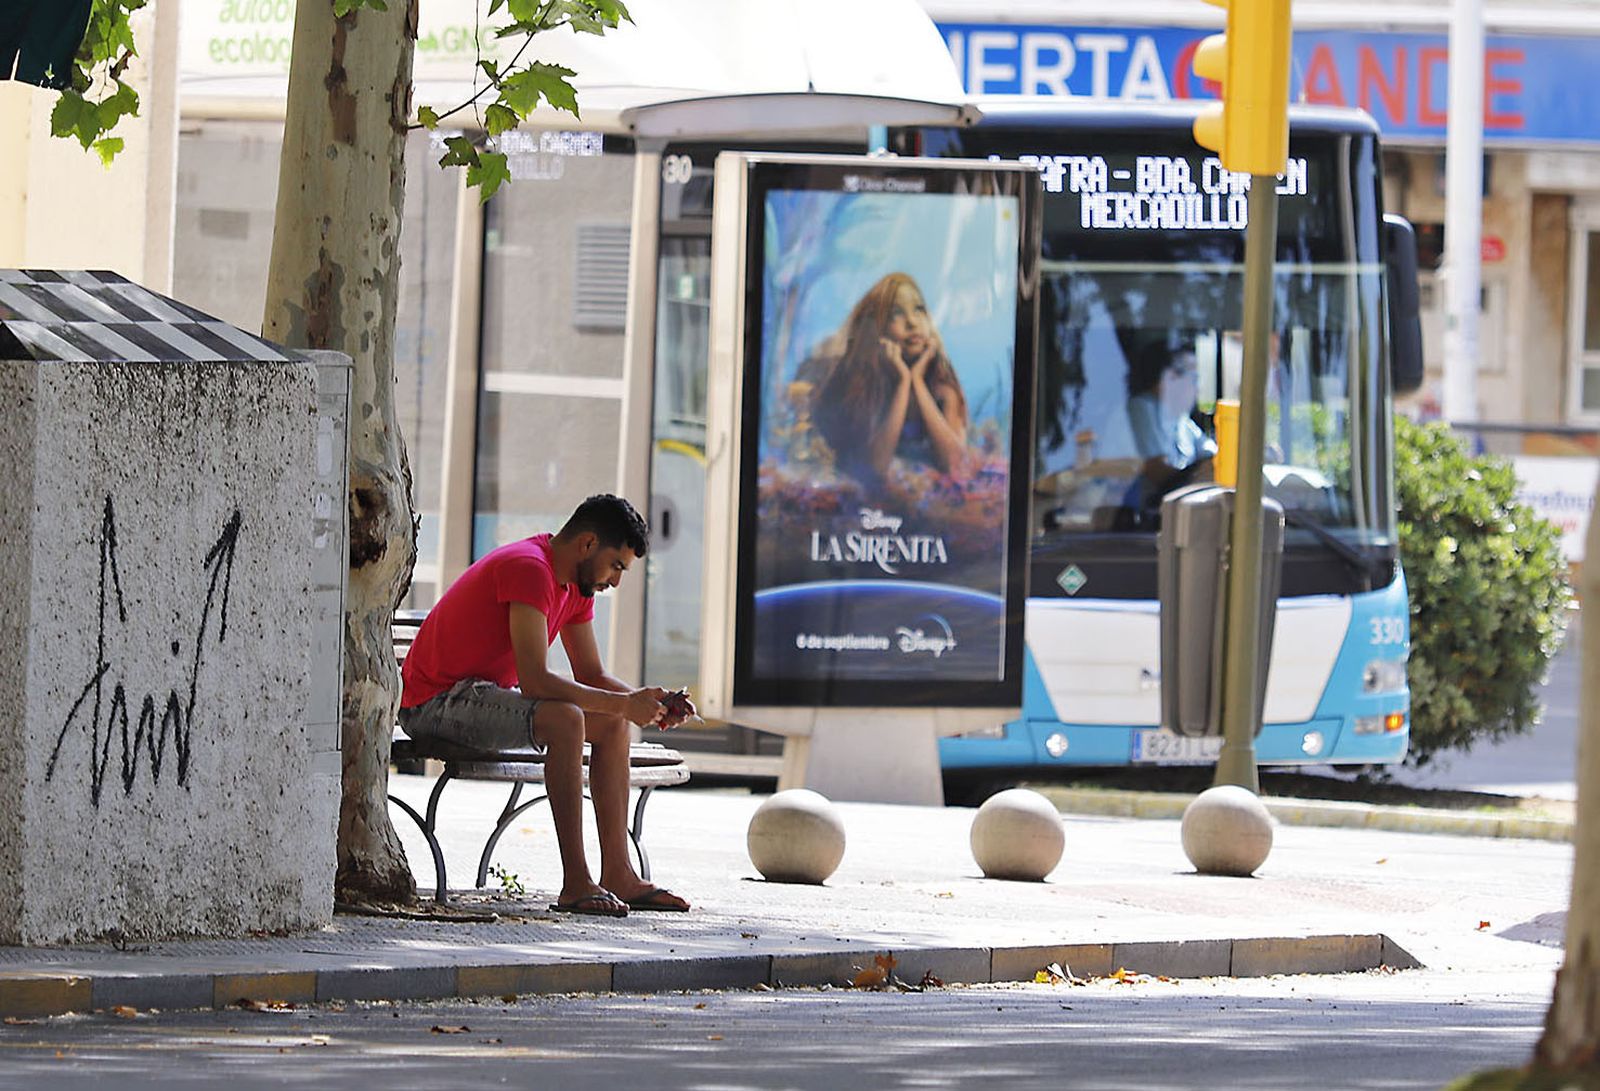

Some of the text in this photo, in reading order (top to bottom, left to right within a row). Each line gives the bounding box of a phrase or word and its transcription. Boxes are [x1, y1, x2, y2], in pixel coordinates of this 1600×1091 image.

[1081, 192, 1248, 229] MERCADILLO
[860, 507, 903, 533] Disney
[811, 530, 948, 575] LA SIRENITA
[824, 633, 890, 652] septiembre
[1369, 616, 1404, 645] 330
